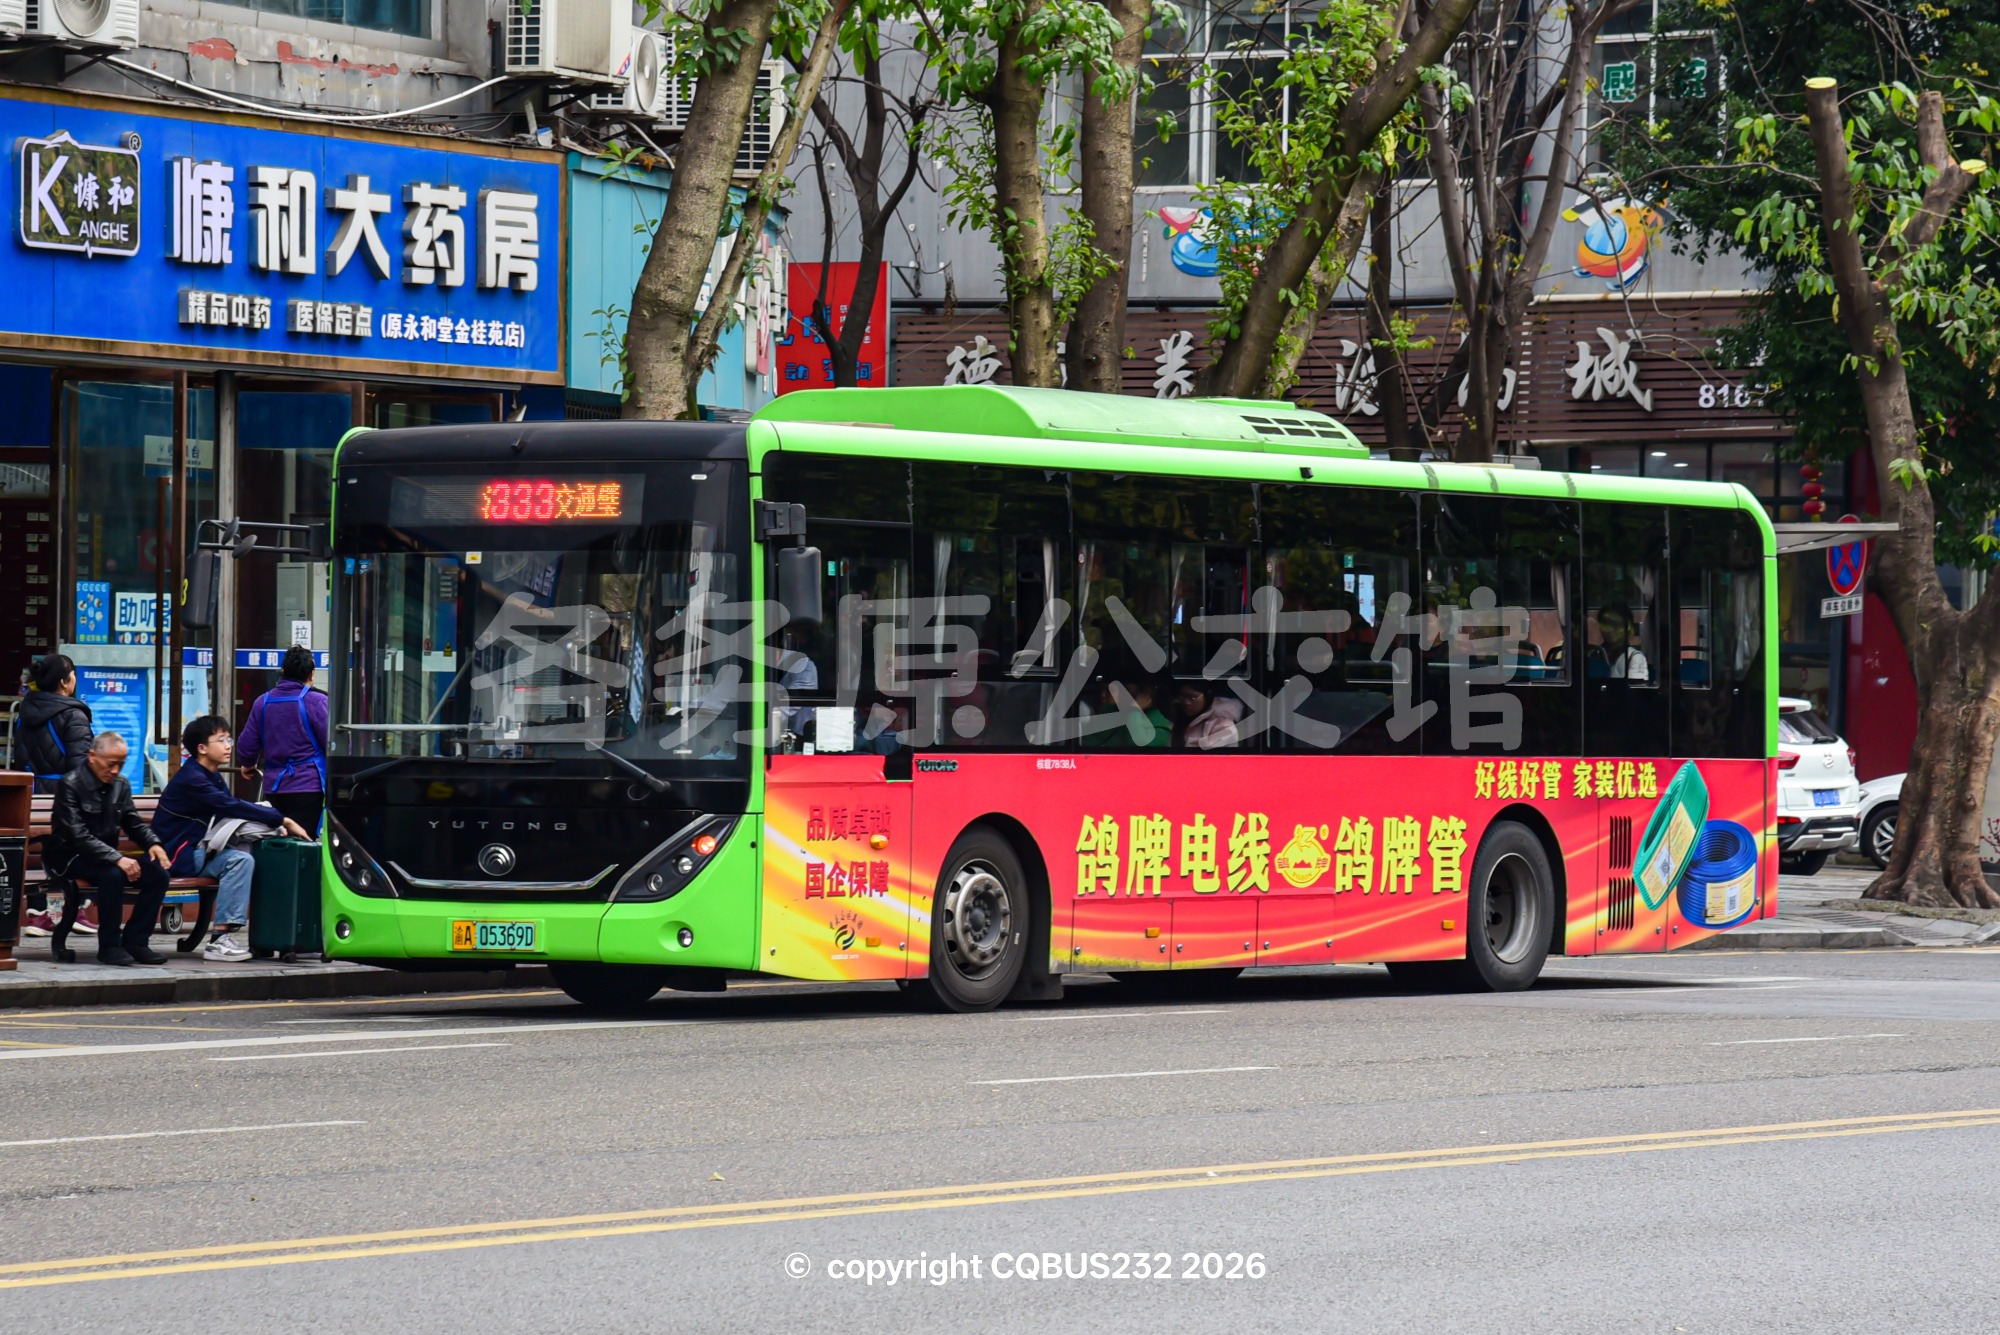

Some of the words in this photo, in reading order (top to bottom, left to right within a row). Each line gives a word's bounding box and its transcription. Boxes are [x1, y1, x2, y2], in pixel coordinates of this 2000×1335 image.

[172, 156, 540, 292] 慷和大药房
[187, 290, 272, 330] 精品中药
[296, 300, 374, 338] 医保定点
[295, 624, 308, 640] 拉
[915, 758, 959, 771] YUTONG
[1475, 760, 1562, 800] 好线好管
[1573, 760, 1658, 800] 家装优选
[428, 820, 567, 831] YUTONG
[806, 804, 892, 841] 品质卓越
[1076, 812, 1271, 896] 鸽牌电线
[1333, 814, 1468, 895] 鸽牌管
[805, 860, 890, 899] 国企保障
